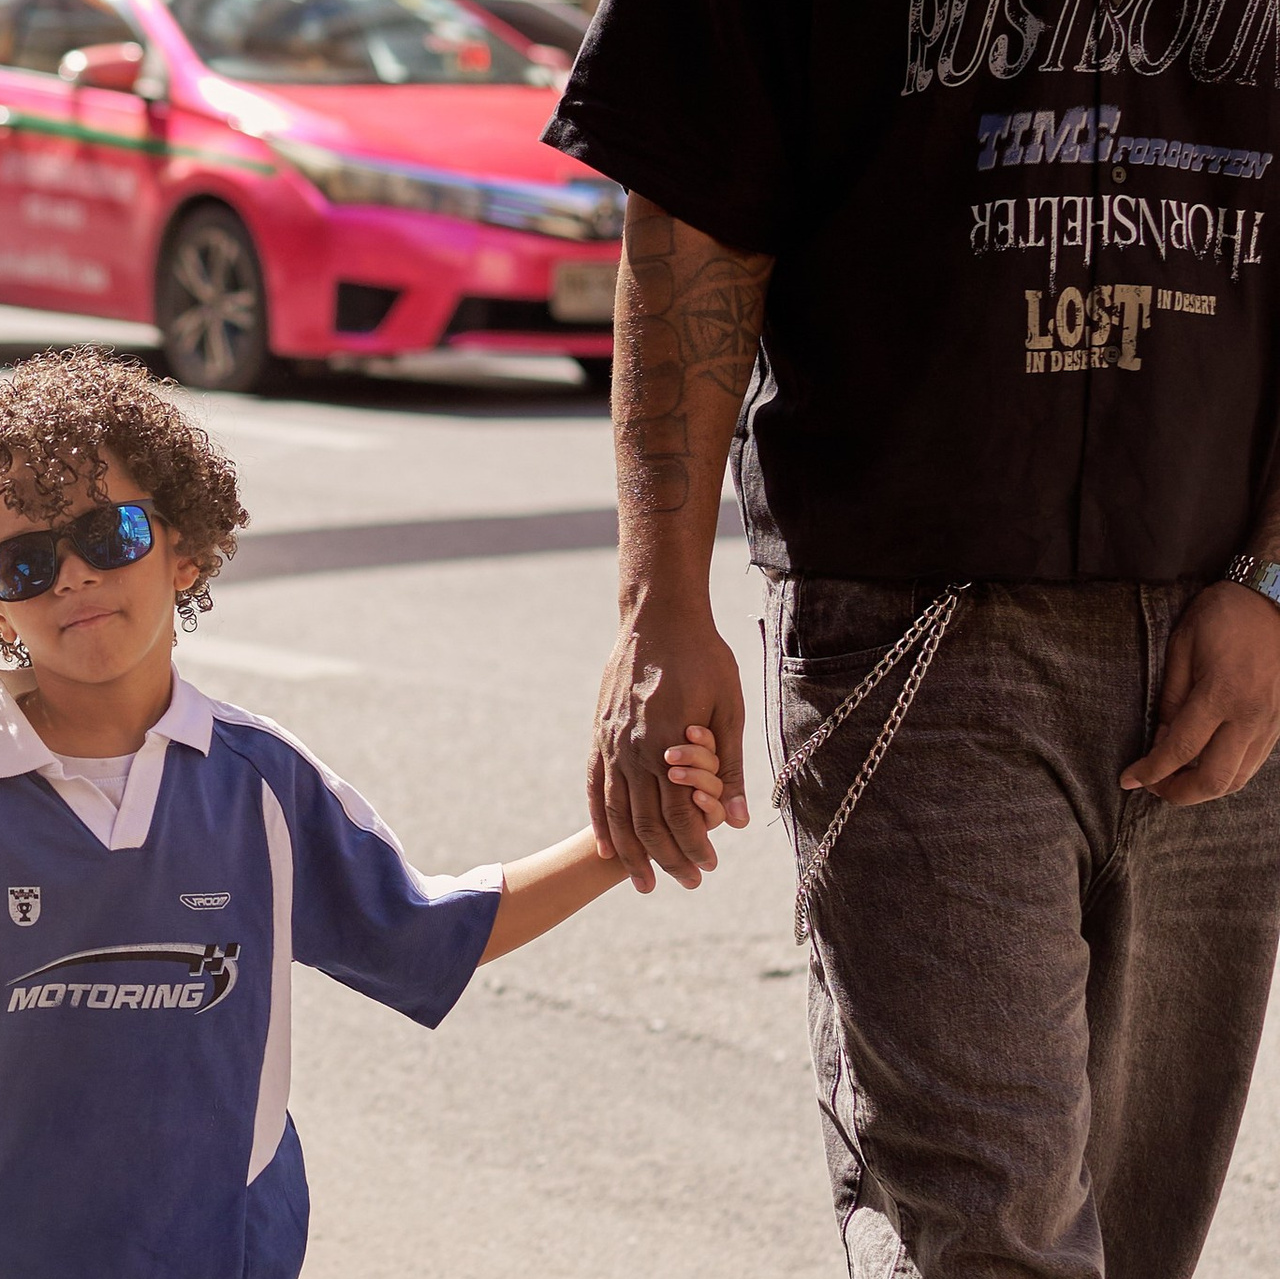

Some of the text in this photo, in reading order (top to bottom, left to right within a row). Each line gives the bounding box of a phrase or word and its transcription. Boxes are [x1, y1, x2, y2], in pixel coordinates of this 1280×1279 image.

[977, 104, 1273, 179] TIME FORGOTTEN
[1024, 284, 1217, 371] LOST IN DESERT
[1026, 350, 1046, 373] IN
[7, 983, 205, 1013] MOTORING
